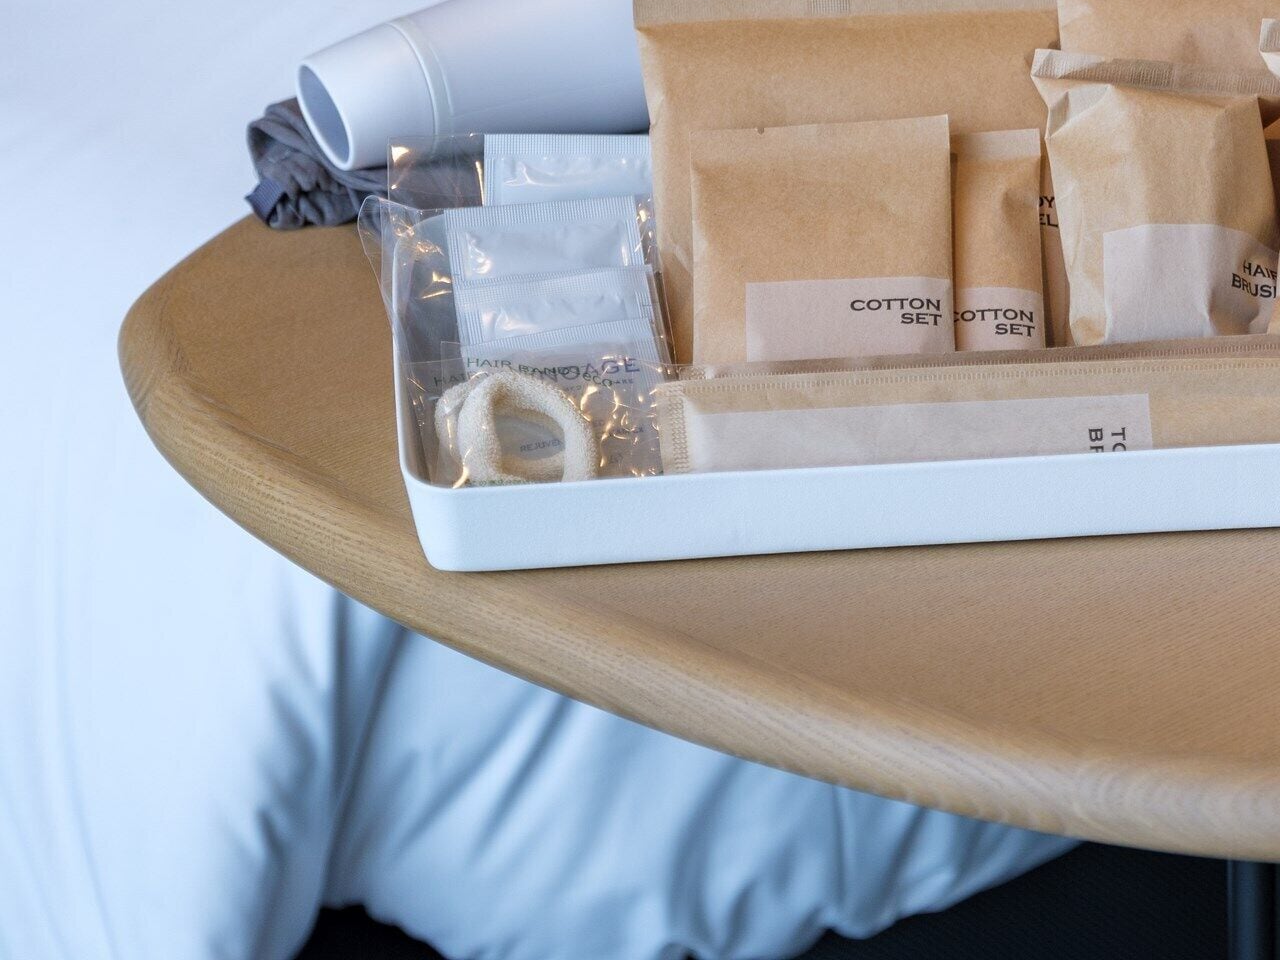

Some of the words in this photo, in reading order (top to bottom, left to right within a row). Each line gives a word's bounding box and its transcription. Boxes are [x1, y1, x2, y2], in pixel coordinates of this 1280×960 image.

[850, 298, 941, 312] COTTON
[900, 312, 943, 326] SET
[994, 323, 1036, 338] SET
